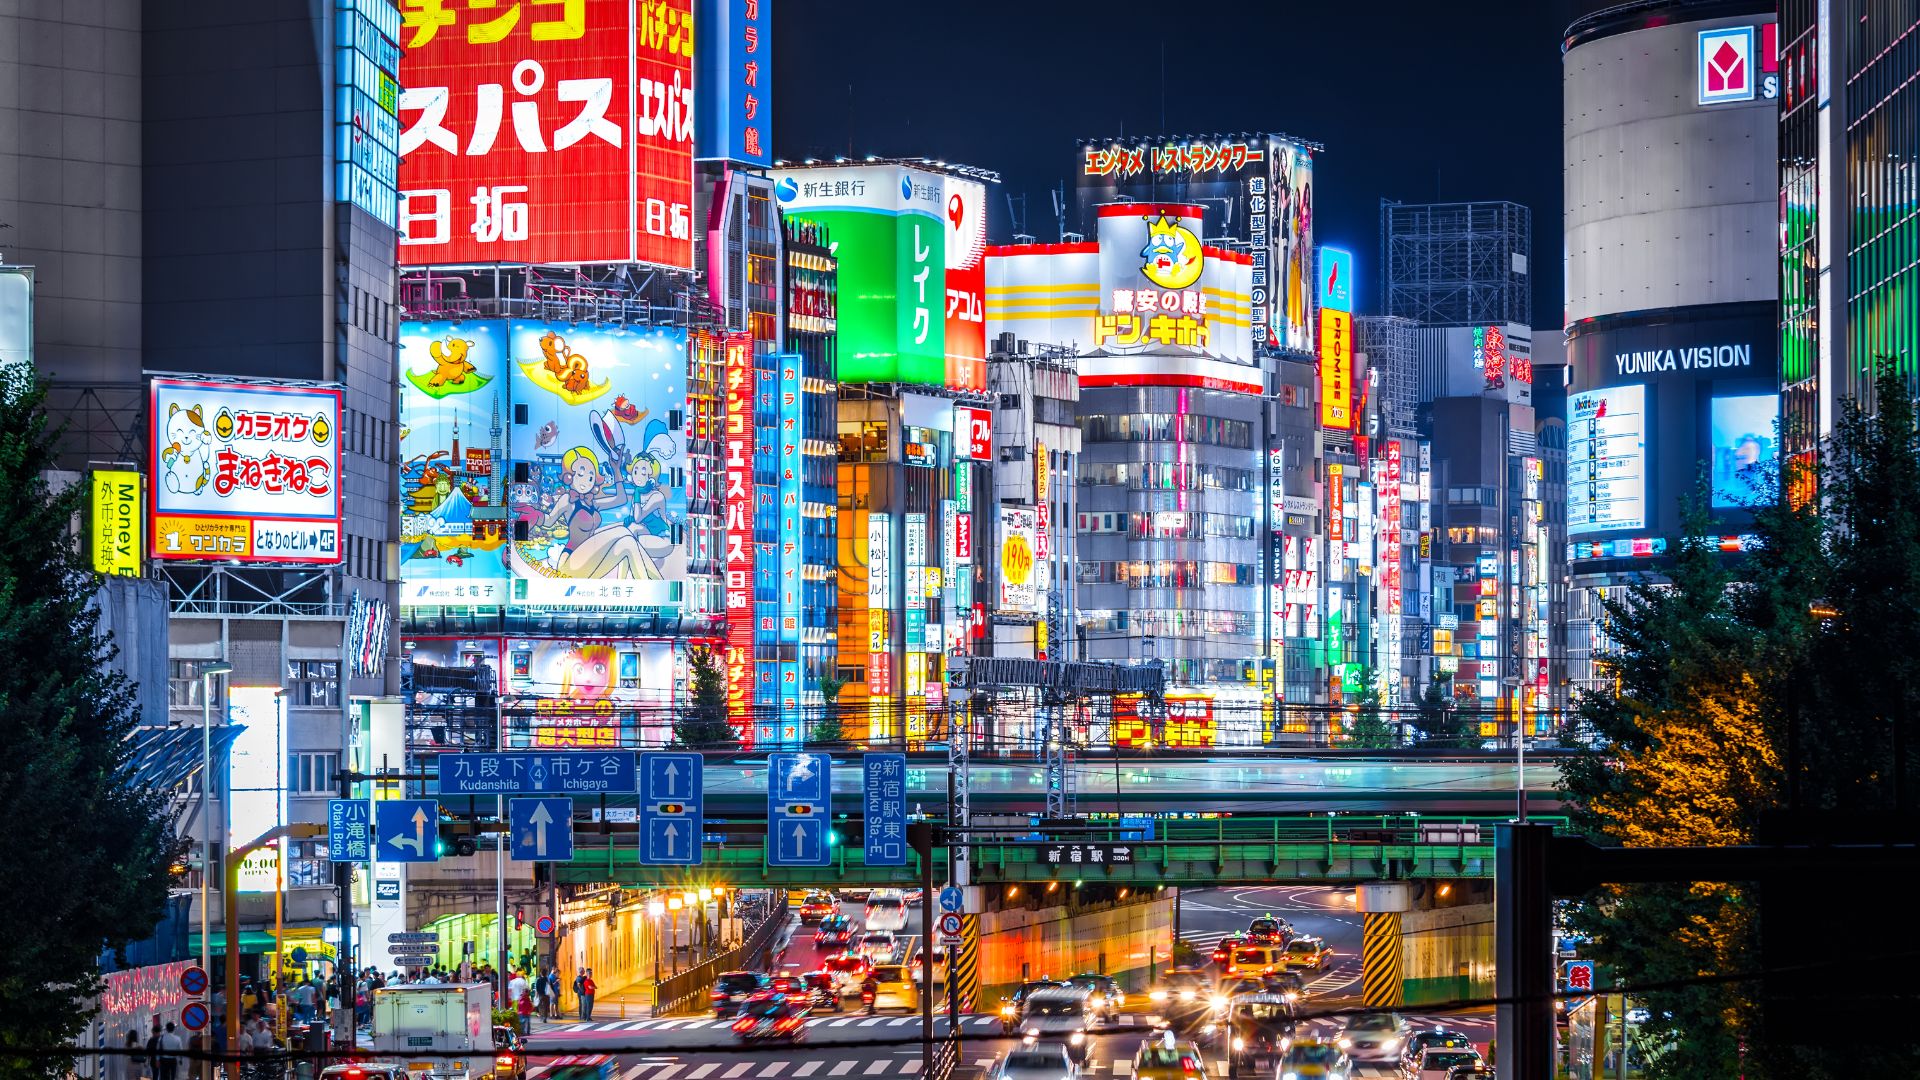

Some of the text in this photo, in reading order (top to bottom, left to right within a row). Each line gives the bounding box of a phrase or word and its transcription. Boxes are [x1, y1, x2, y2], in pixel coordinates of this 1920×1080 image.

[1764, 76, 1778, 99] S
[639, 69, 694, 143] エスパス
[803, 180, 866, 198] 新生銀行
[914, 184, 941, 204] 新生銀行
[1251, 177, 1266, 342] 進化型居酒屋の聖地
[913, 224, 930, 345] レイク
[945, 288, 983, 323] アコム
[1333, 317, 1341, 400] PROMISE
[1616, 344, 1751, 375] YUNIKA VISION
[727, 345, 746, 434] パチンコ
[236, 413, 310, 440] カラオケ
[214, 447, 331, 495] まねきねこ
[101, 481, 114, 566] 外币兑换
[118, 484, 131, 557] Money
[195, 523, 247, 533] ひとりカラオケ専門店
[189, 535, 247, 552] ワンカラ
[256, 528, 336, 550] となりのビル 4F
[959, 523, 968, 557] アイフル
[870, 529, 882, 595] 小松ビル
[454, 584, 495, 597] 北電子
[600, 586, 635, 597] 北電子
[728, 647, 746, 716] パチンコ
[537, 727, 615, 746] 超大型店
[455, 757, 525, 778] 九段下
[534, 768, 542, 779] 4
[460, 778, 608, 792] Kudanshita Ichigaya
[869, 762, 882, 812] Shinjuku
[594, 810, 635, 818] 新大ガード西
[882, 759, 901, 859] 新宿駅東口
[332, 803, 343, 858] Otaki Brdg.
[345, 803, 366, 858] 小滝橋
[242, 857, 277, 870] 0:00
[1048, 850, 1104, 862] 新宿駅
[1569, 965, 1592, 990] 祭
